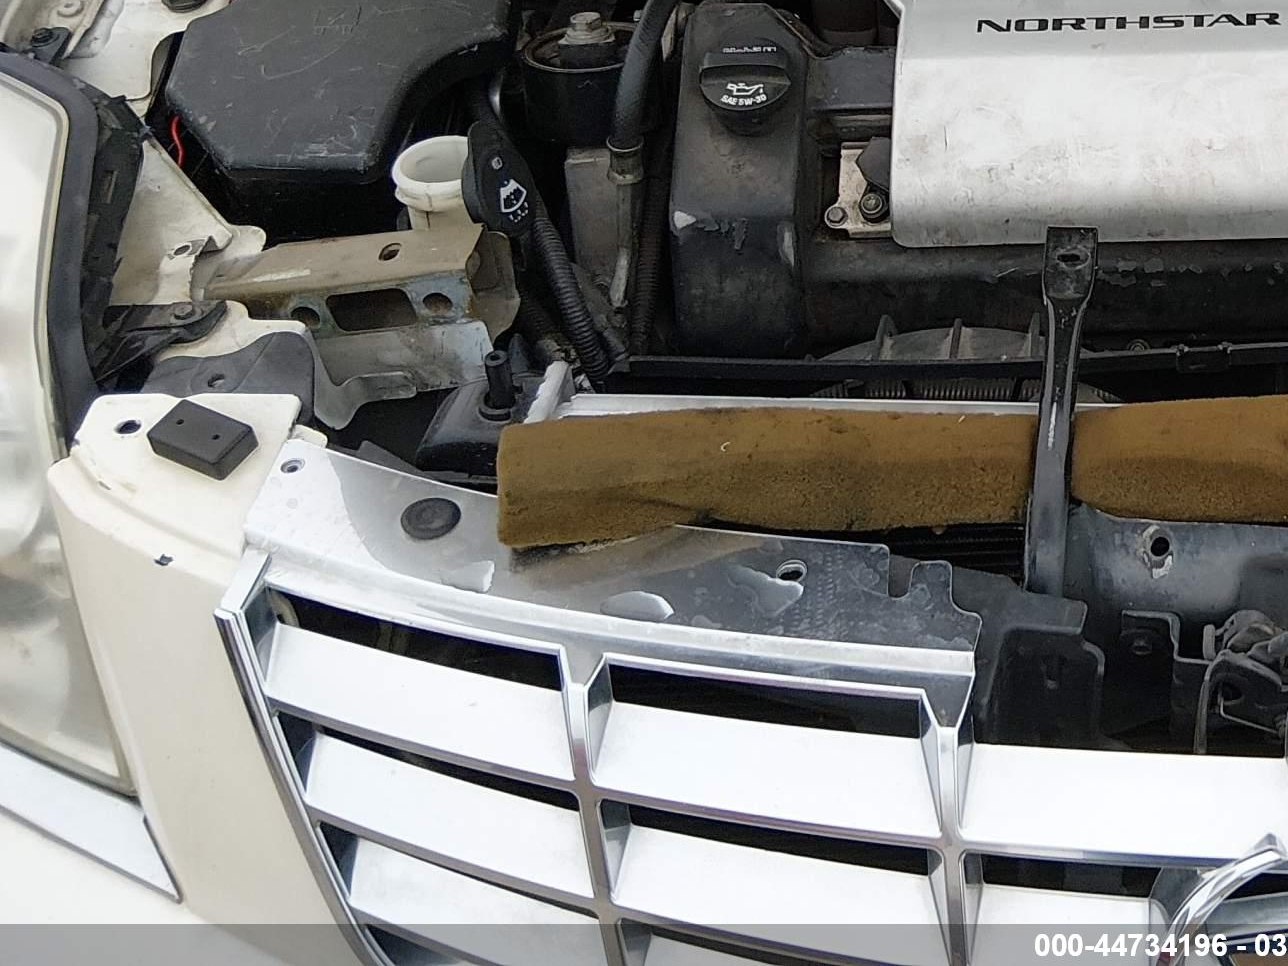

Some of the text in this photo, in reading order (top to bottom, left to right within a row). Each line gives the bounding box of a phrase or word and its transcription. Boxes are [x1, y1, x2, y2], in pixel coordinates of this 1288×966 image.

[977, 13, 1281, 32] NORTHSTAR
[721, 94, 767, 106] SAE 5W-30
